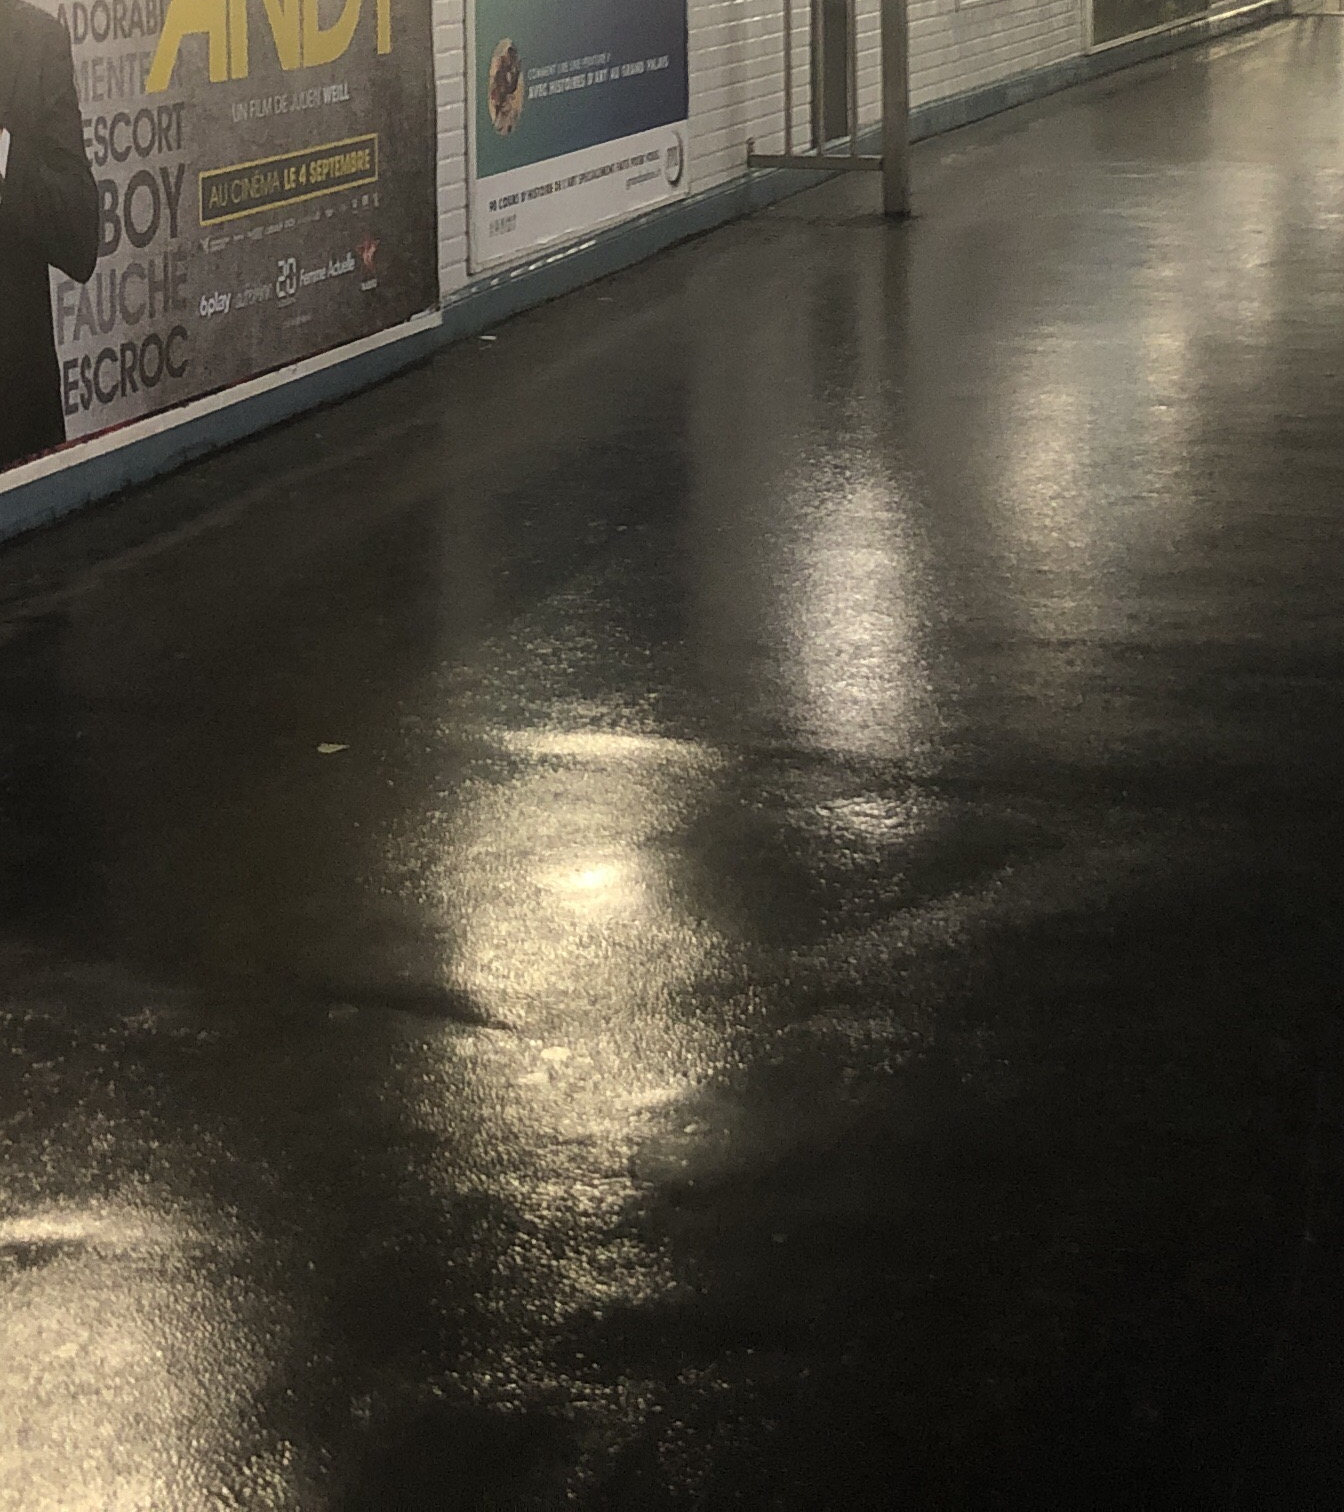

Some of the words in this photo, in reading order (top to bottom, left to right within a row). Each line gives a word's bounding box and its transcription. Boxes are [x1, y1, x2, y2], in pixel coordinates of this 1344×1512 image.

[83, 102, 185, 167] ESCORT
[97, 163, 186, 259] BOY
[208, 185, 228, 210] AU
[230, 168, 281, 204] CINÉMA
[283, 167, 297, 191] LE
[299, 162, 307, 187] 4
[309, 148, 371, 184] SEPTEMBRE
[57, 245, 189, 346] FAUCHE
[199, 290, 232, 319] 6play
[64, 325, 189, 416] ESCROC
